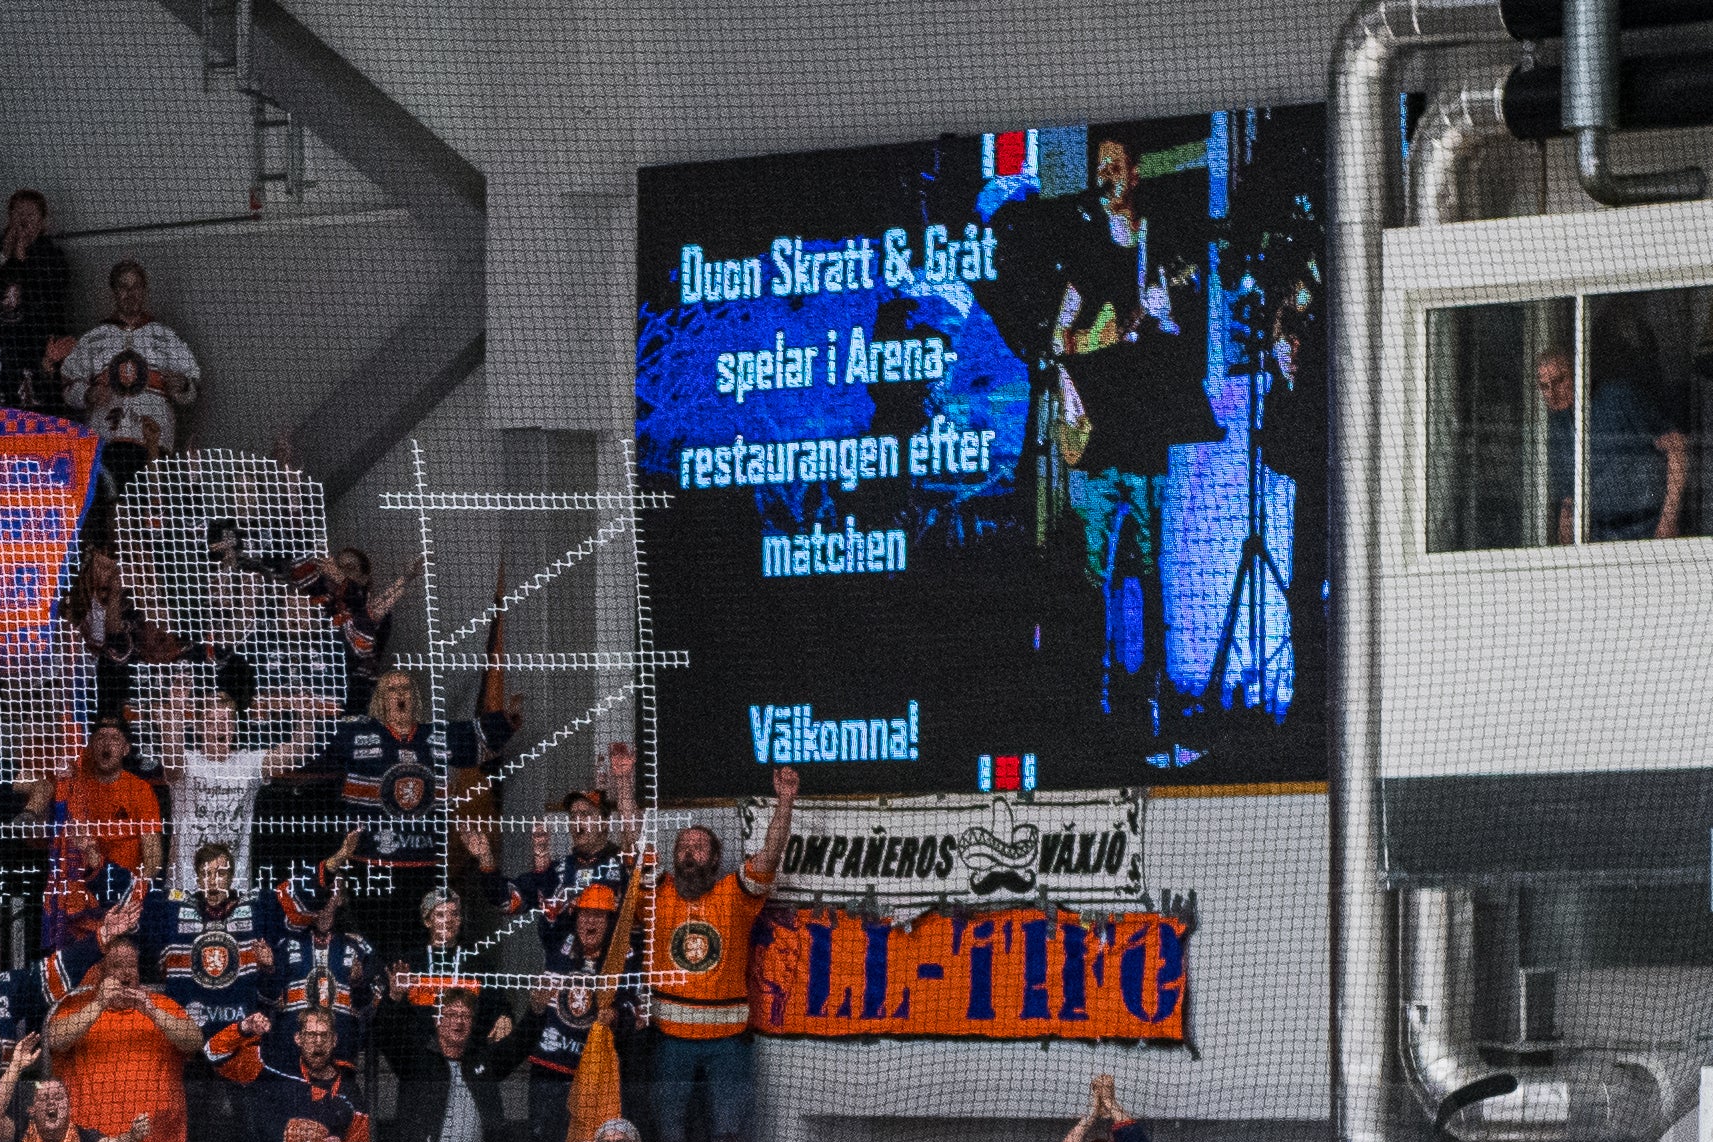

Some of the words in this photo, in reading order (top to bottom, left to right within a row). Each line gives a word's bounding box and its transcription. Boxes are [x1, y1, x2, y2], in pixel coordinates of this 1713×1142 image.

[680, 244, 762, 304] Duon
[770, 236, 874, 297] Skratt
[883, 227, 914, 288] &
[924, 223, 998, 282] Gråt
[715, 331, 819, 403] spelar
[826, 329, 838, 386] i
[845, 326, 958, 386] Arena-
[679, 434, 900, 492] restaurangen
[908, 415, 996, 477] efter
[762, 515, 908, 578] matchen
[749, 700, 920, 764] Välkomna!
[784, 826, 958, 880] OMPAÑEROS
[205, 1006, 246, 1023] VIDA
